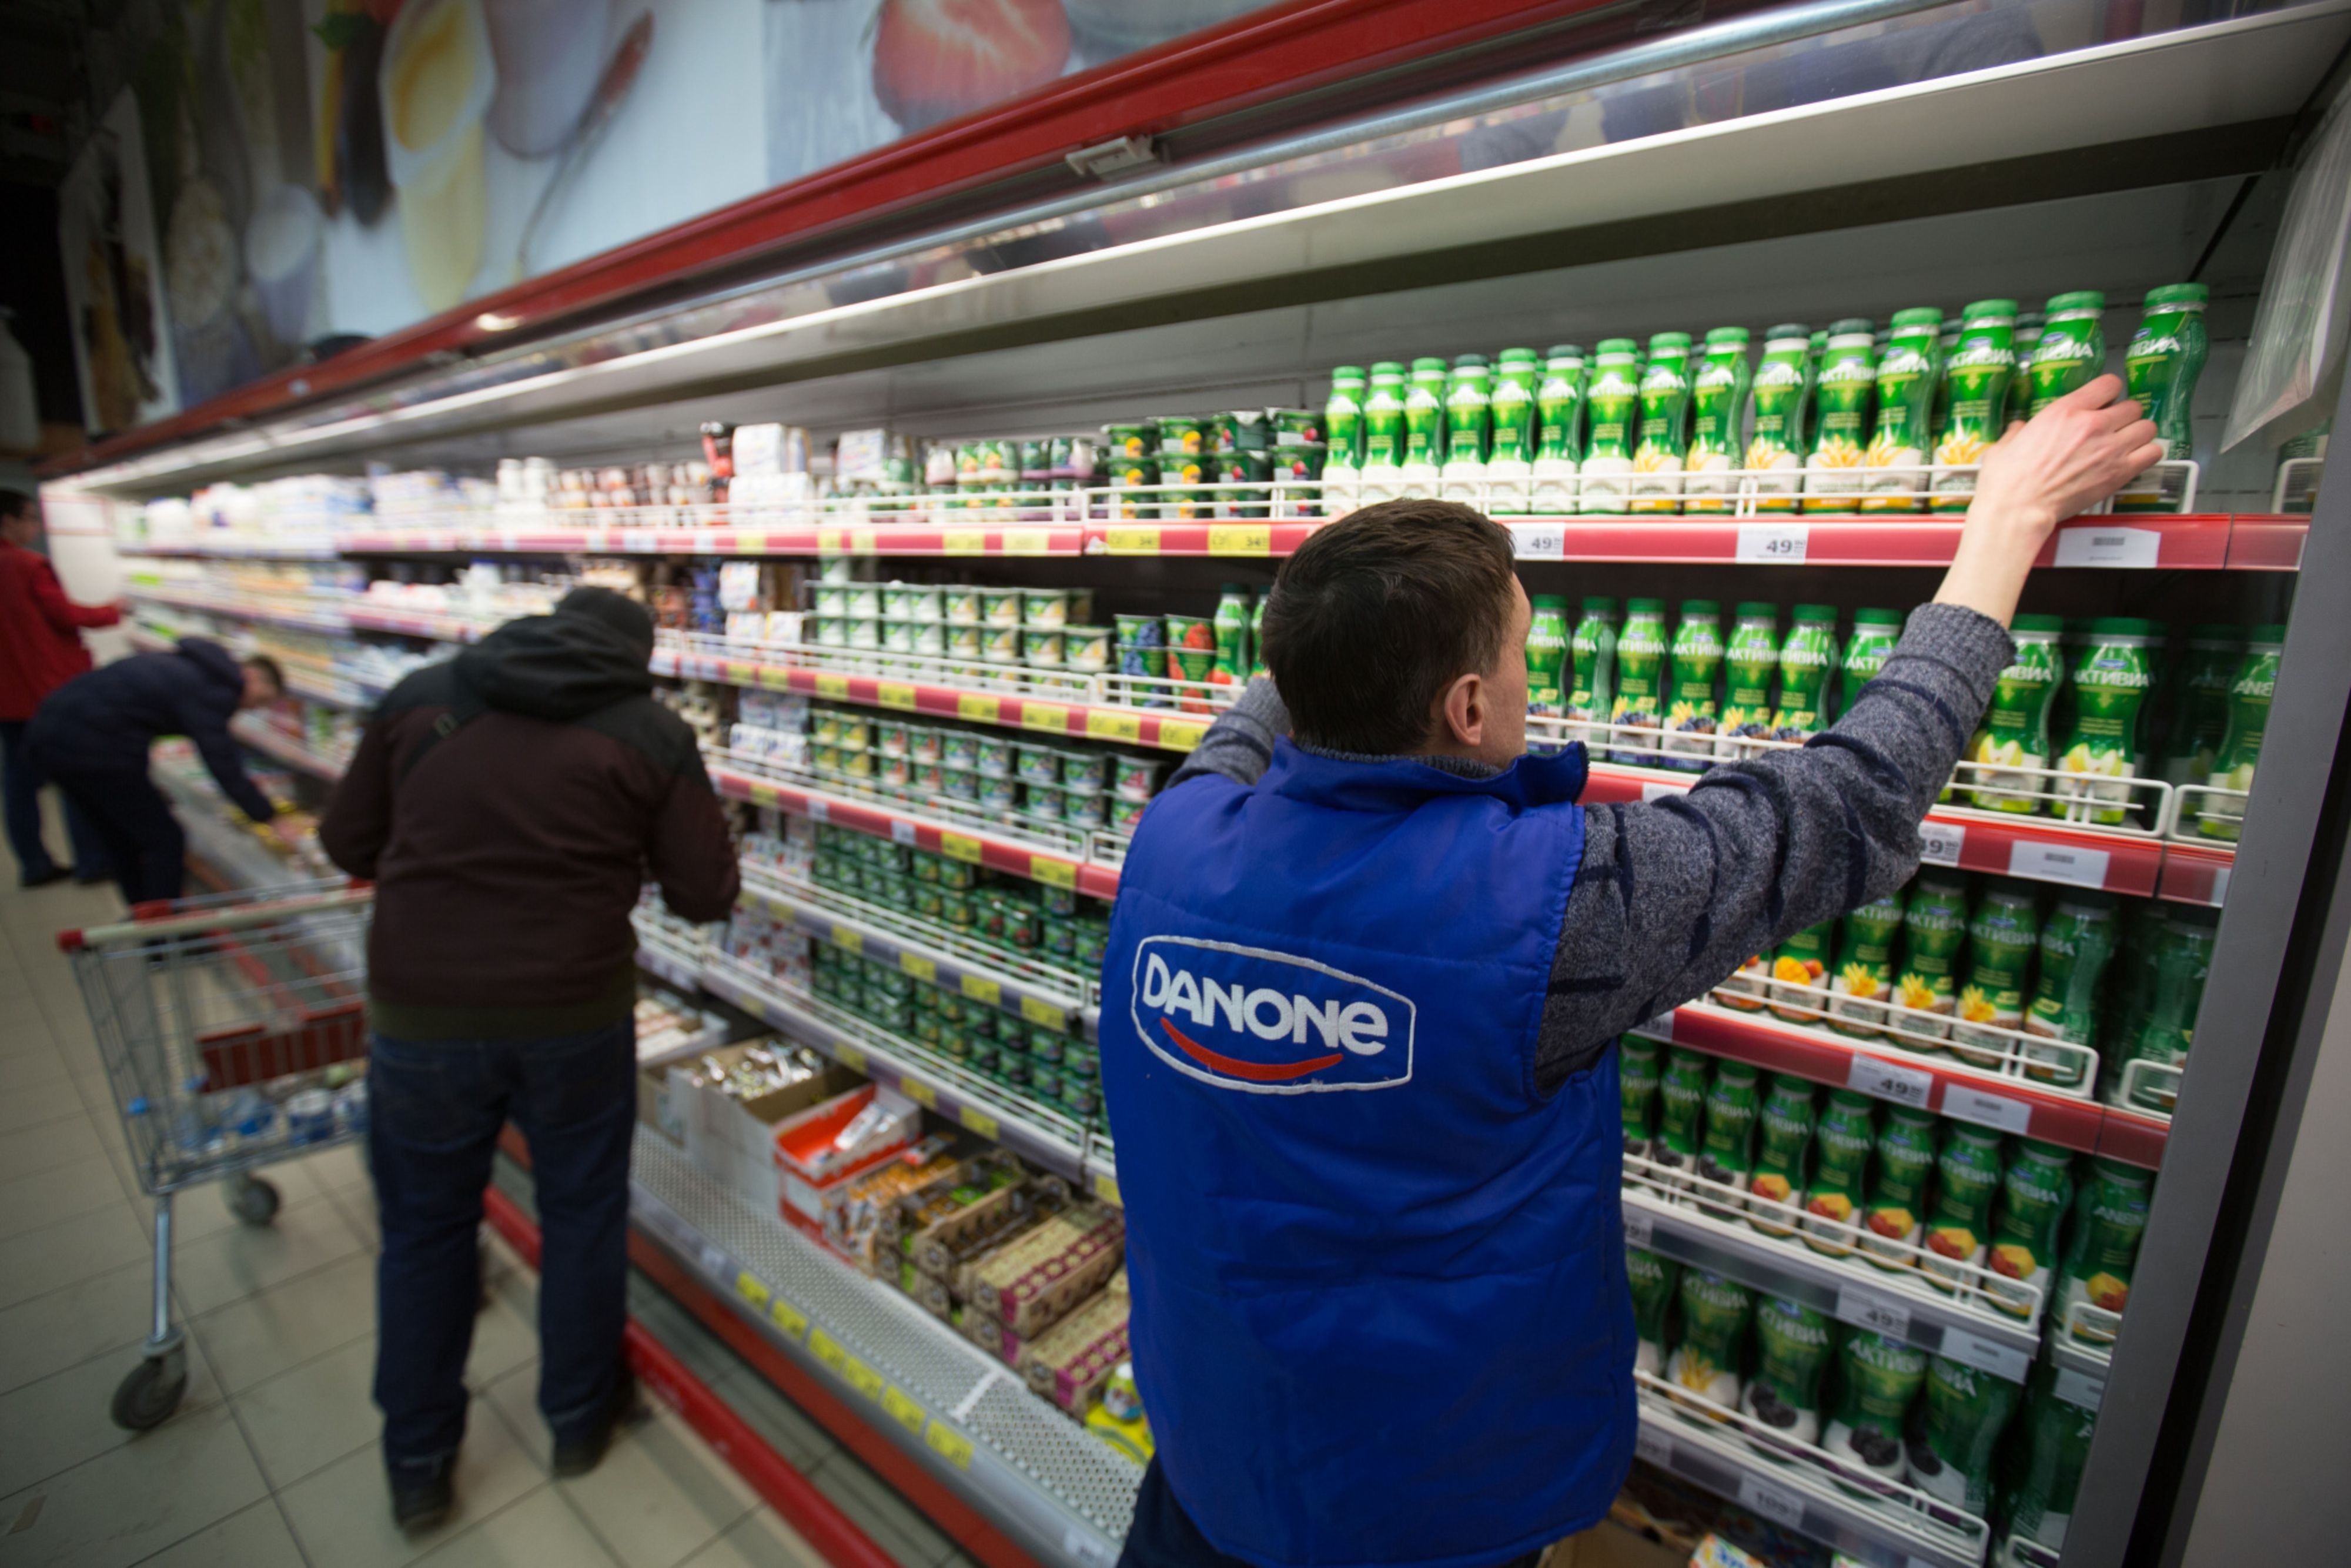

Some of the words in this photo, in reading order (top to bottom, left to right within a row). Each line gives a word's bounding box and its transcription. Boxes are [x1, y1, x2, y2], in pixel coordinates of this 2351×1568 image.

[1531, 537, 1553, 550] 49
[1766, 540, 1792, 553] 49
[1673, 643, 1724, 657] АКТИВИ
[1881, 1078, 1908, 1094] 49
